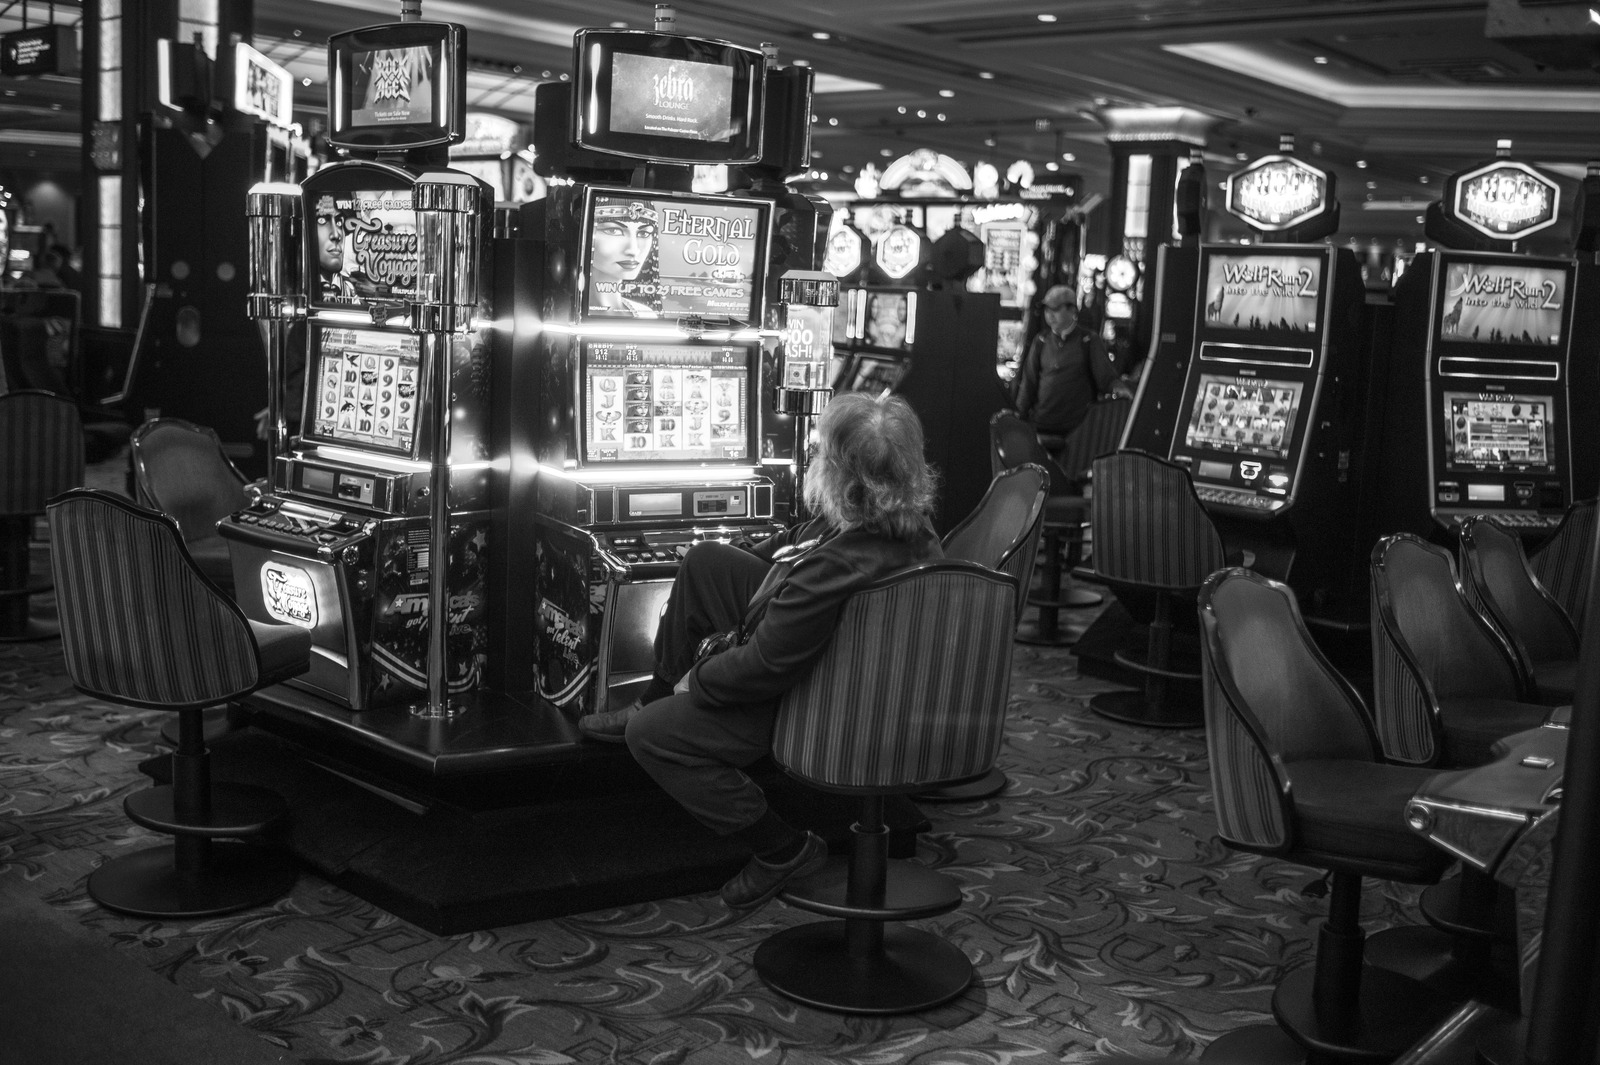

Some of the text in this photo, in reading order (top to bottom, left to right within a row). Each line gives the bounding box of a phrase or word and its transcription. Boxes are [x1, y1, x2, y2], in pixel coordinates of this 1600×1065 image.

[652, 65, 693, 106] zebra
[659, 100, 690, 110] LOUNGE
[336, 200, 352, 210] WIN
[344, 217, 418, 253] Treasure
[356, 250, 419, 286] Voyage
[1298, 267, 1317, 298] 2
[595, 282, 744, 298] WIN UP TO 25 FREE GAMES
[1463, 273, 1511, 294] Wolf
[1541, 280, 1561, 310] 2
[1492, 297, 1511, 308] the
[327, 360, 340, 374] K
[364, 356, 377, 370] Q
[383, 358, 395, 372] 9
[344, 370, 357, 384] 10
[382, 374, 394, 388] 9
[401, 368, 415, 382] K
[343, 385, 356, 399] K
[599, 378, 618, 393] Q
[325, 391, 337, 404] Q
[361, 386, 374, 402] A
[381, 390, 392, 404] 9
[399, 401, 411, 414] 9
[600, 394, 616, 409] J
[325, 406, 336, 419] 9
[379, 406, 391, 419] 9
[718, 409, 731, 423] 9
[358, 419, 372, 433] 10
[397, 415, 410, 431] K
[660, 418, 676, 432] 10
[600, 427, 617, 441] K
[659, 434, 676, 448] K
[630, 436, 647, 449] 10
[385, 591, 480, 616] Amca's
[405, 615, 423, 629] got
